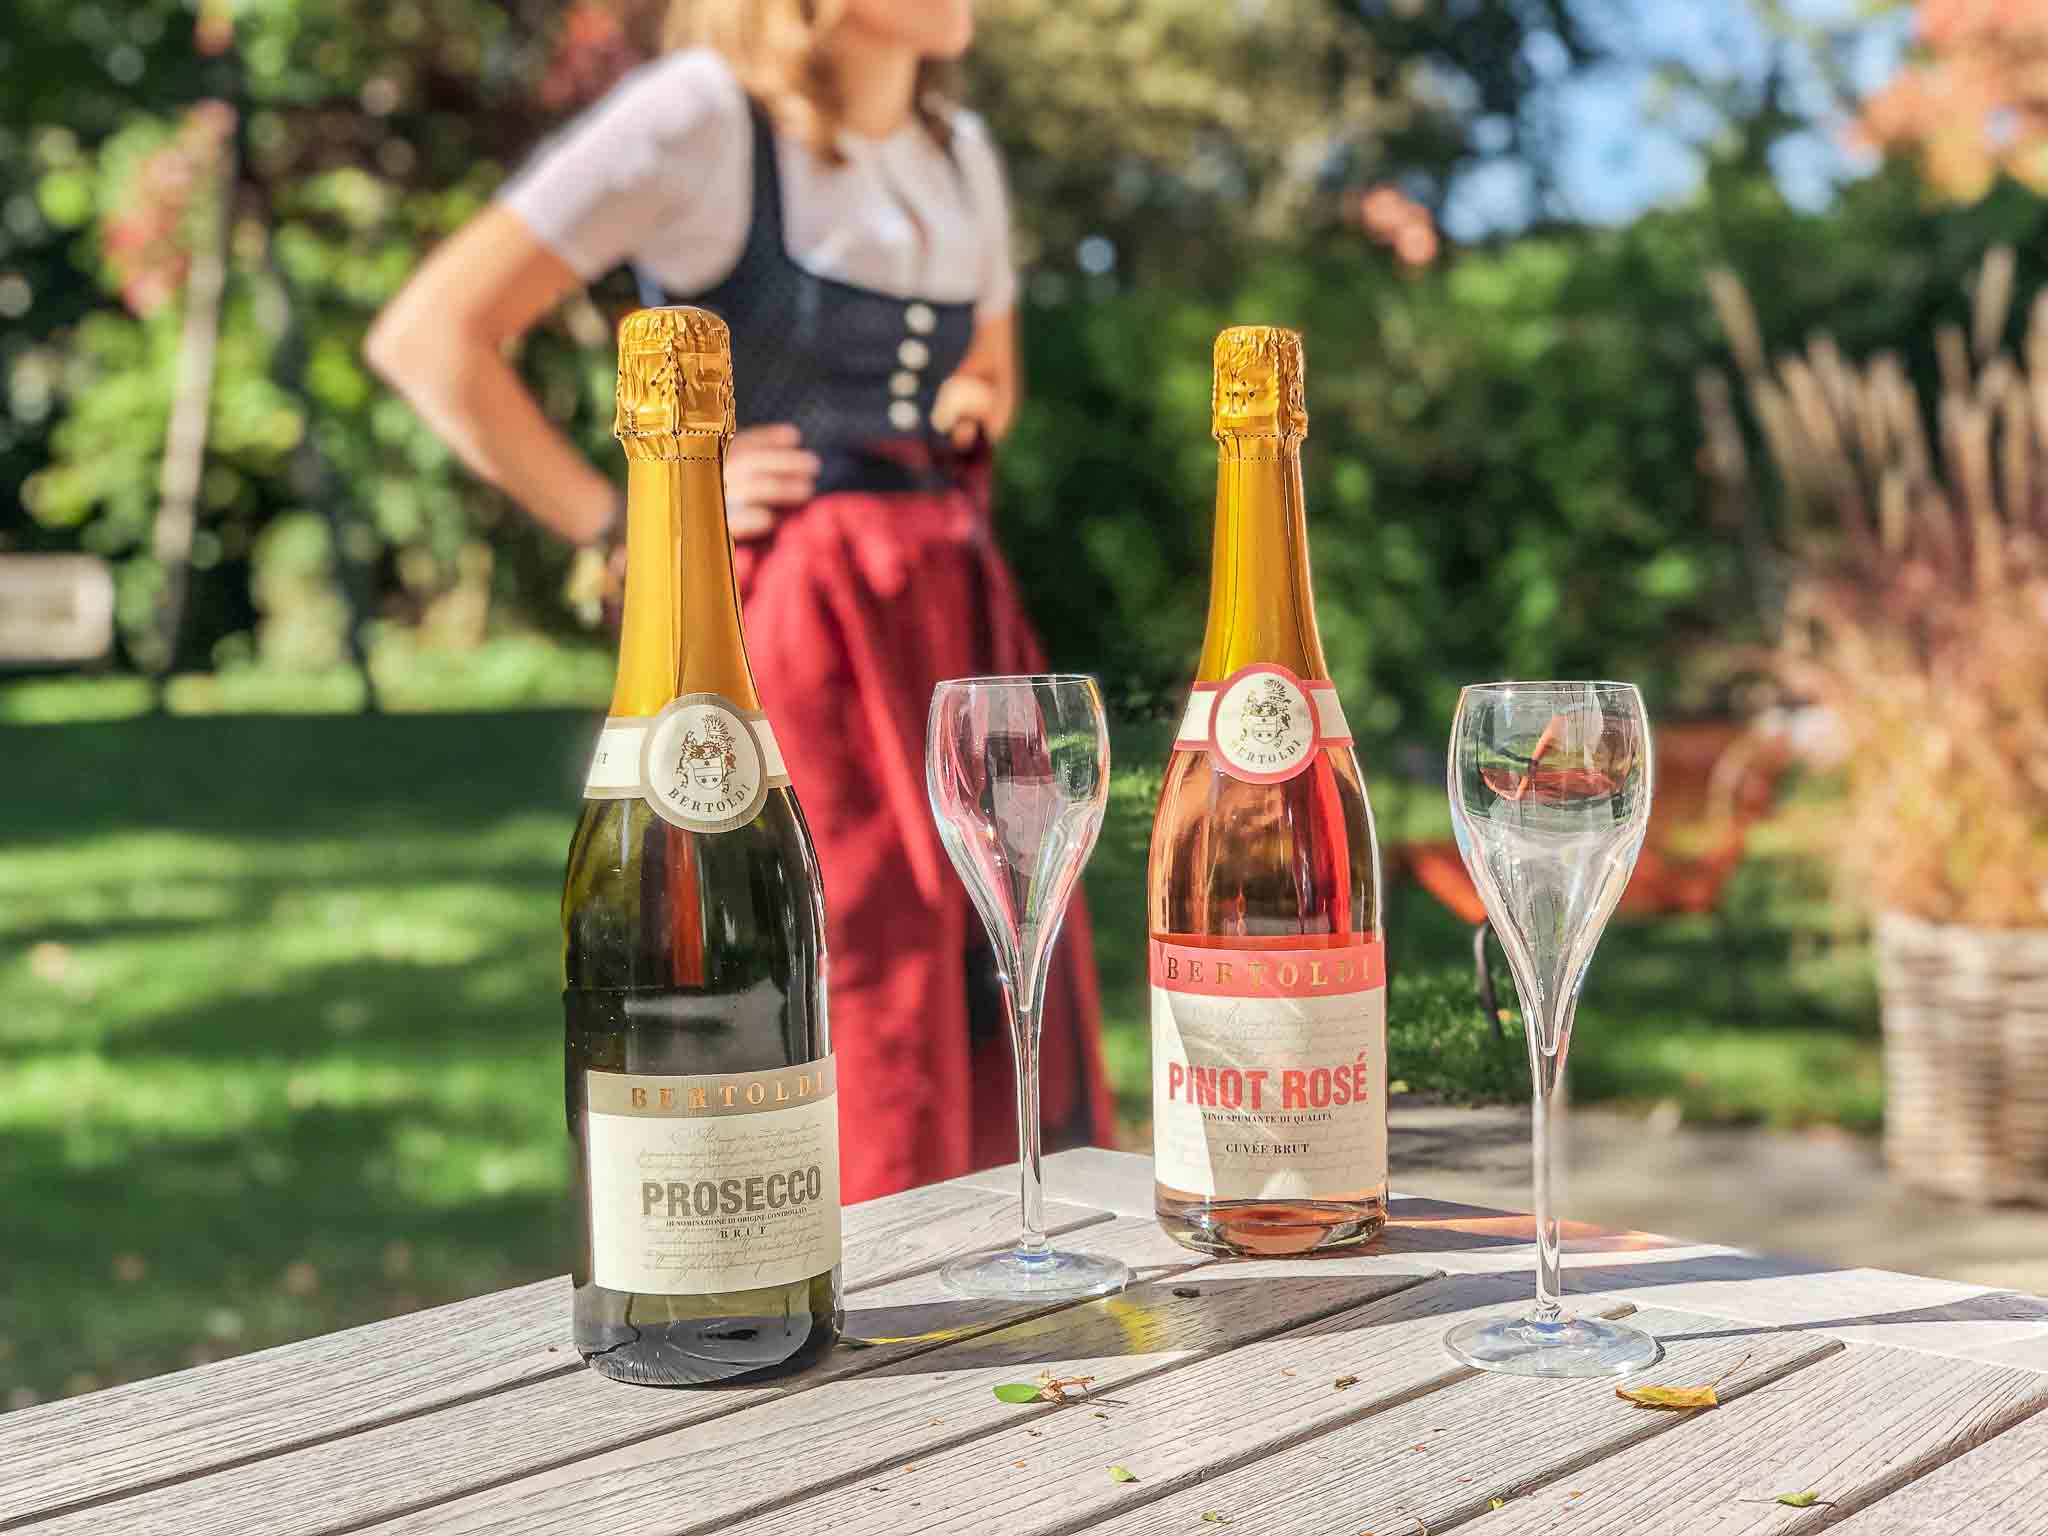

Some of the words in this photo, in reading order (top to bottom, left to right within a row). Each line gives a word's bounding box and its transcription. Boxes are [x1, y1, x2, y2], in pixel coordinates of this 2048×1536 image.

[667, 783, 752, 813] BERTOLDI
[1167, 957, 1369, 987] BERTOLDI
[631, 1071, 824, 1109] BERTOLDI
[1168, 1061, 1269, 1111] PINOT
[1282, 1050, 1368, 1110] ROSÉ
[1202, 1111, 1225, 1122] VINO
[1226, 1112, 1276, 1124] SPUMANTE
[1279, 1114, 1291, 1124] DI
[1226, 1141, 1270, 1155] CUVÉE
[1273, 1143, 1310, 1155] BRUT
[641, 1165, 822, 1217] PROSECCO
[666, 1216, 727, 1228] DENOMINAZIONE
[737, 1213, 766, 1225] ORIGINE
[720, 1225, 768, 1239] BRUT
